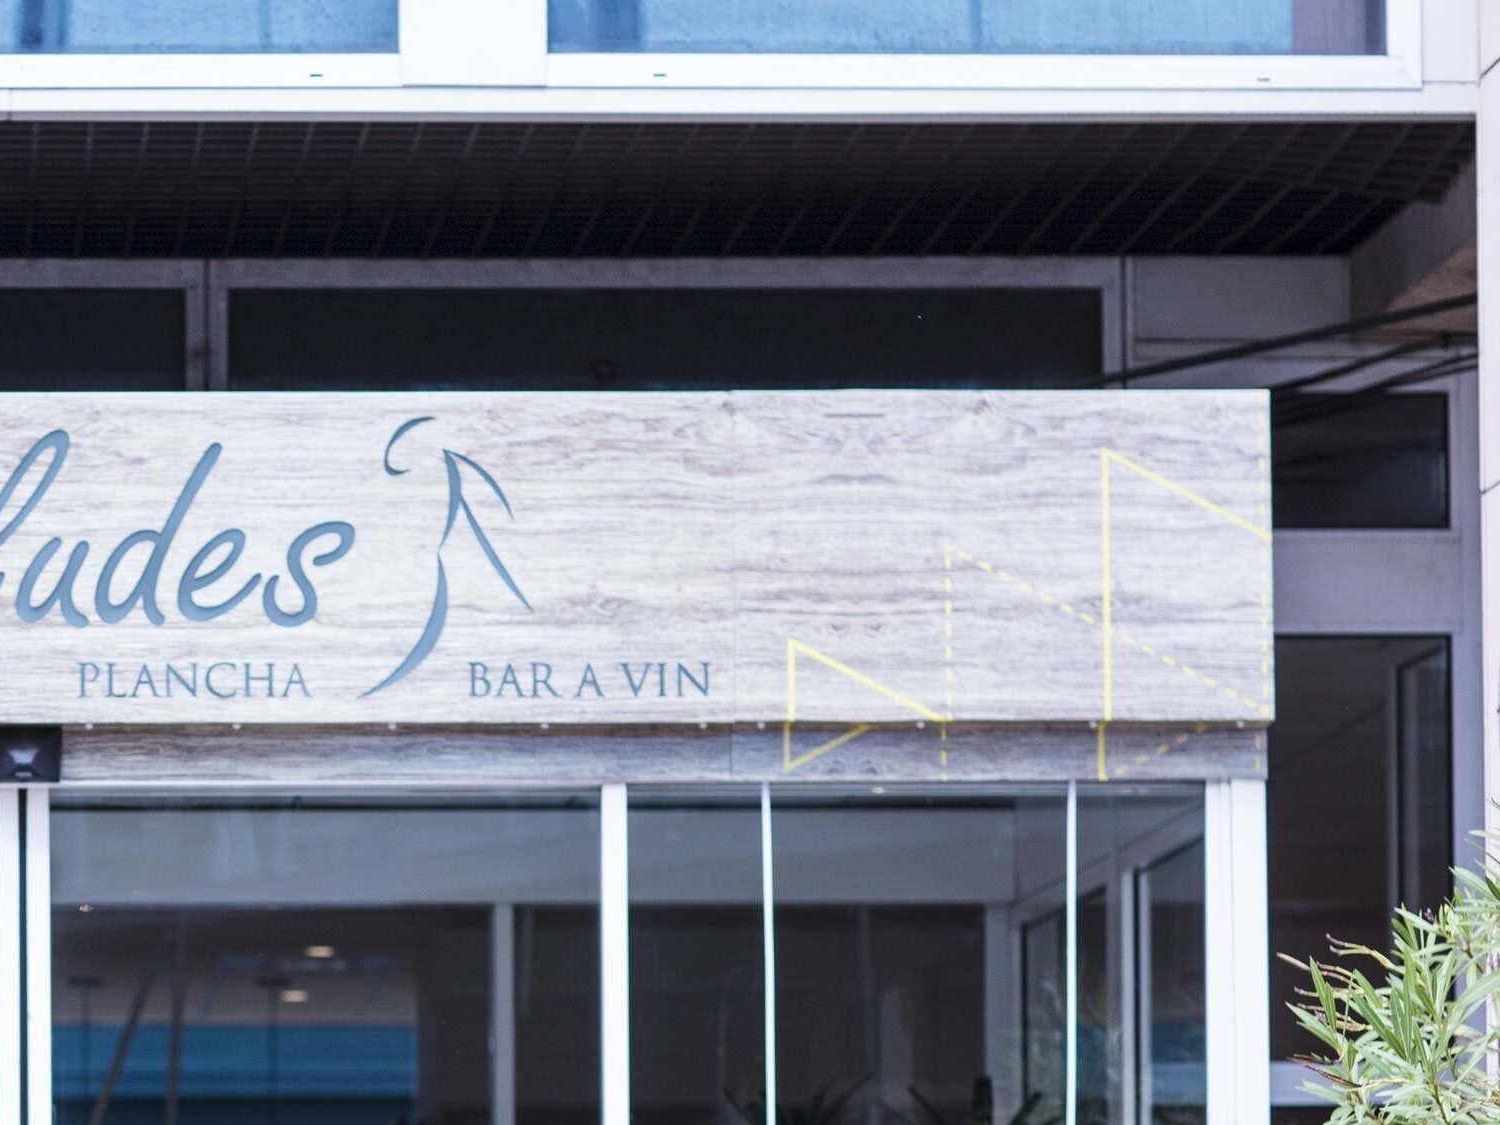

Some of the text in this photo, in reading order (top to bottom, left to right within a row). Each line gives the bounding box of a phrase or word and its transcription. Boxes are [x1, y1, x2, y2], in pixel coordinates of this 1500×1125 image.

[78, 661, 310, 699] PLANCHA
[468, 661, 562, 698] BAR
[574, 662, 604, 698] A
[620, 661, 711, 698] VIN
